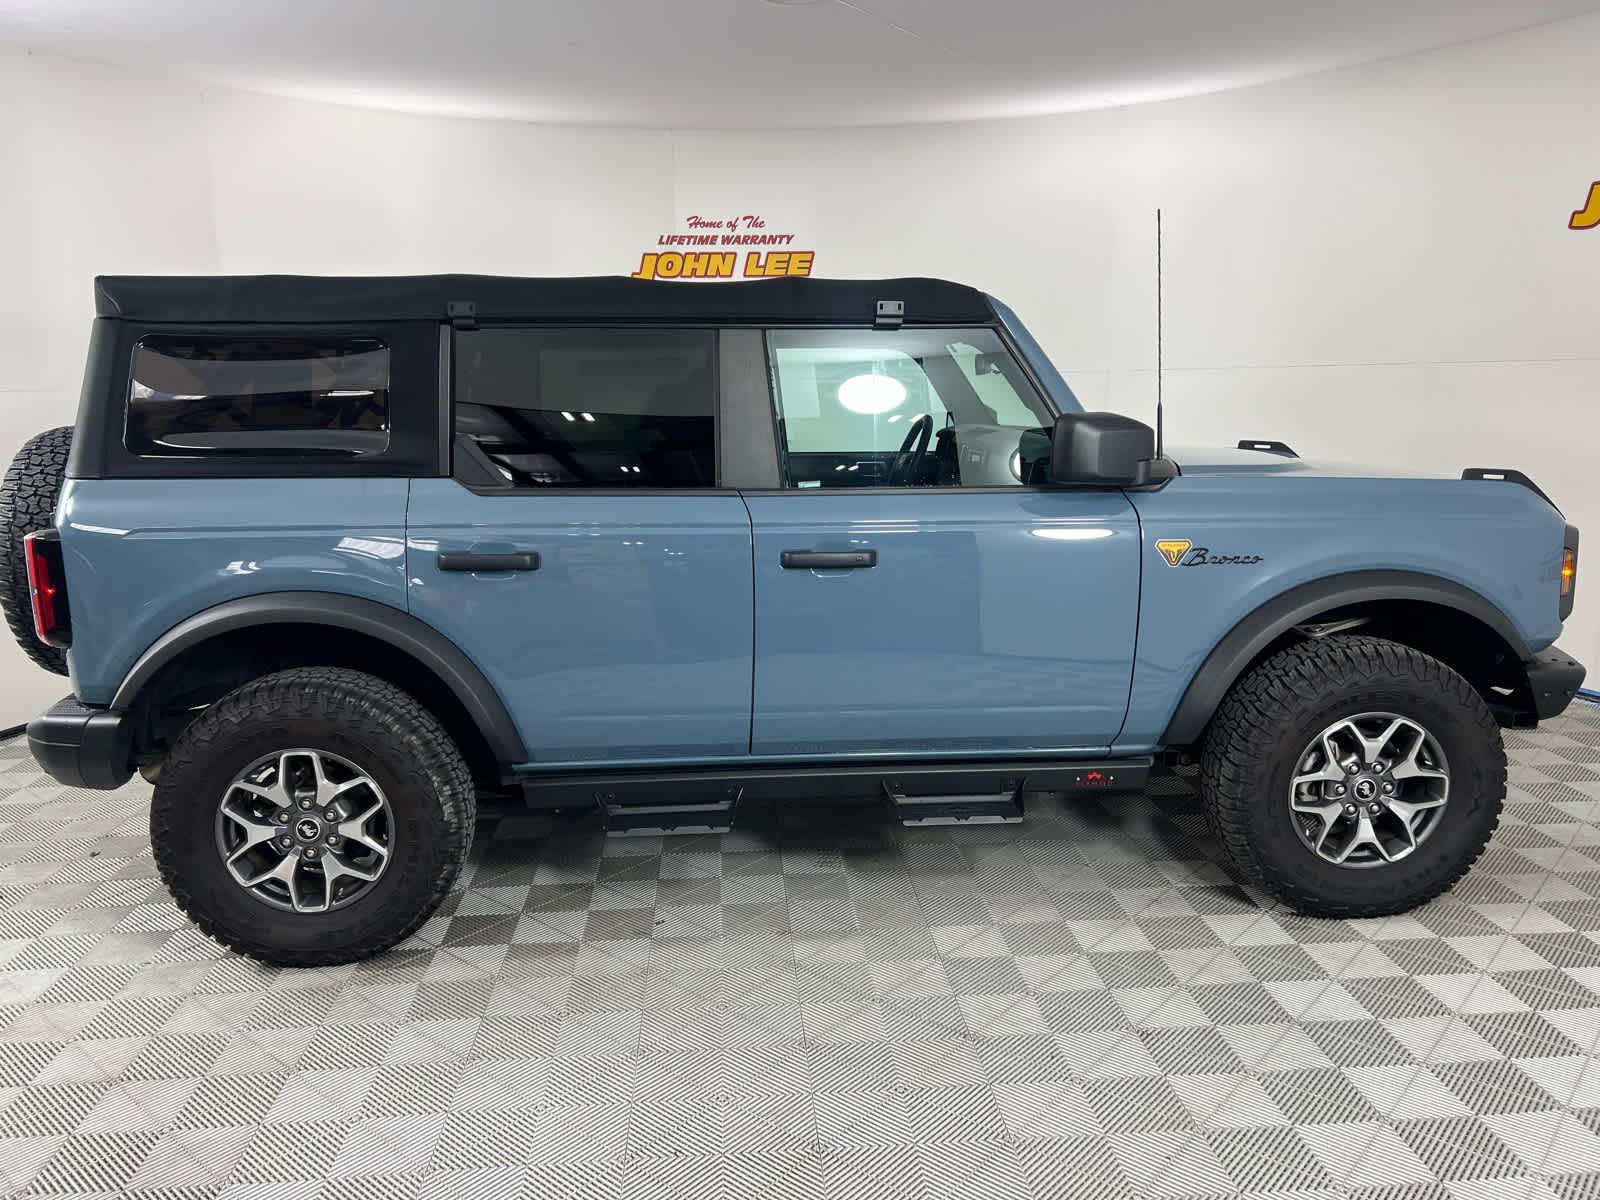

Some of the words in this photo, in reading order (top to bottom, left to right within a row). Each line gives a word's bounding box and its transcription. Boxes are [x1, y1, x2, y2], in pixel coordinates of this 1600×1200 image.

[686, 215, 723, 229] Home
[726, 217, 738, 232] of
[743, 215, 765, 229] The
[658, 235, 718, 245] LIFETIME
[721, 234, 794, 245] WARRANTY
[631, 251, 737, 280] JOHN
[743, 251, 815, 277] LEE
[1181, 547, 1264, 567] Bronco
